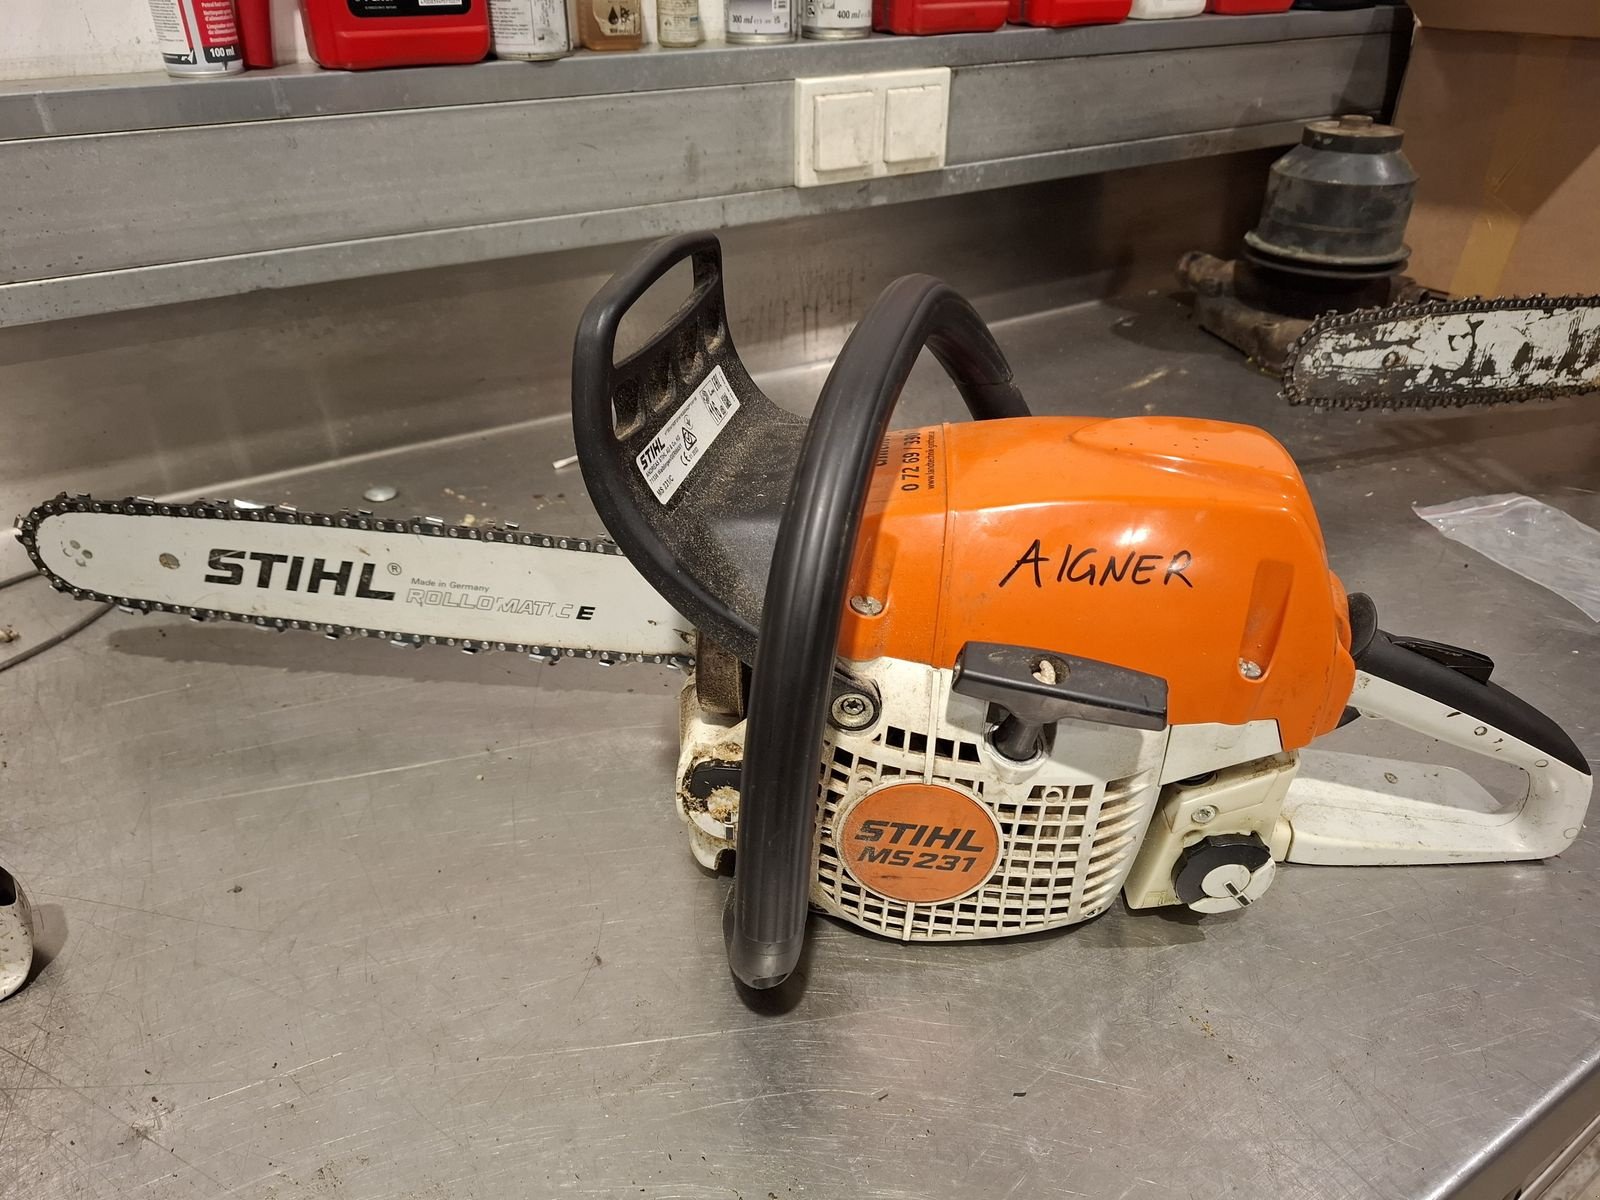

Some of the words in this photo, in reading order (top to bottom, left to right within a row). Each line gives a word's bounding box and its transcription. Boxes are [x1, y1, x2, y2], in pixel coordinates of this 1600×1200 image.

[837, 10, 850, 19] 400
[209, 47, 225, 58] 100
[226, 46, 235, 56] ml
[639, 436, 666, 471] STIHL
[902, 452, 920, 464] 69
[901, 466, 920, 480] 72
[901, 483, 919, 491] 0
[998, 539, 1193, 588] AIGNER
[204, 548, 396, 601] STIHL
[411, 577, 436, 587] Made
[437, 579, 447, 588] in
[449, 581, 490, 593] Germany
[405, 588, 573, 619] ROLLOMATIC
[854, 819, 985, 853] STIHL
